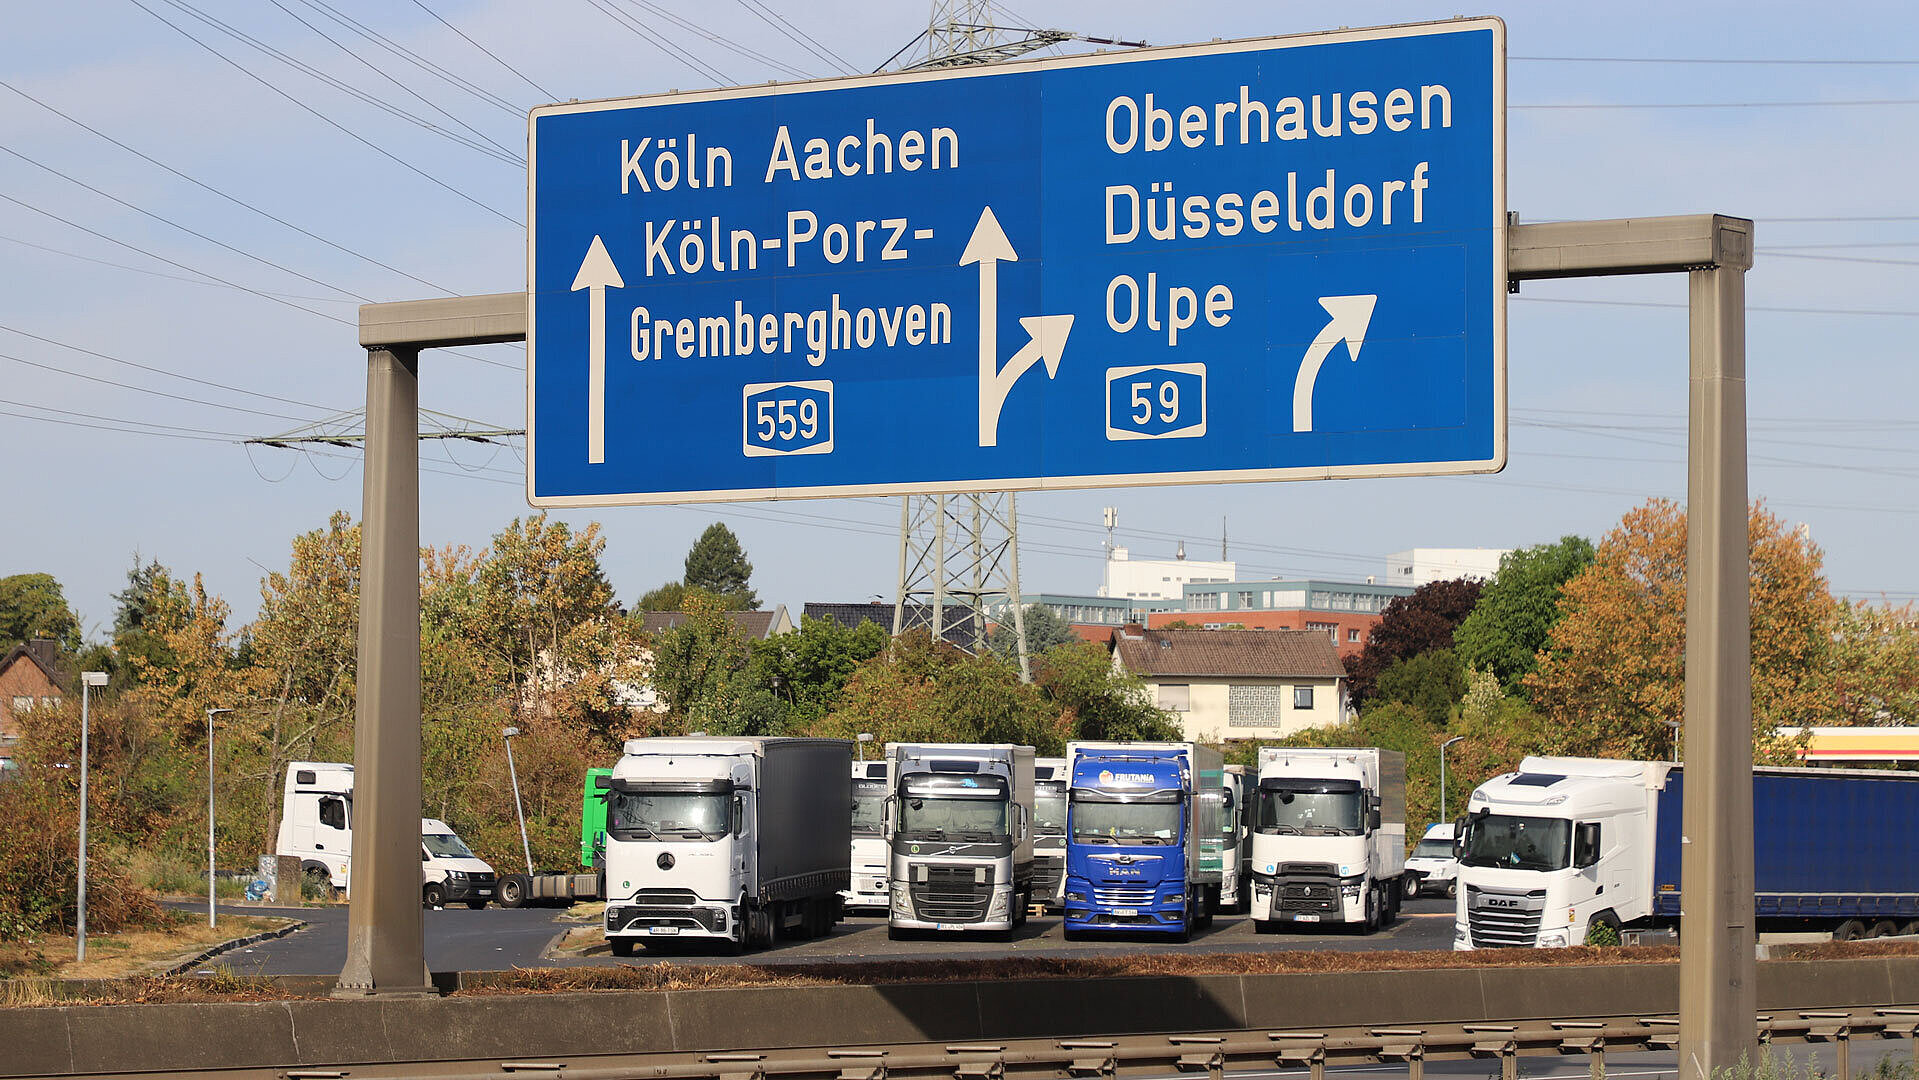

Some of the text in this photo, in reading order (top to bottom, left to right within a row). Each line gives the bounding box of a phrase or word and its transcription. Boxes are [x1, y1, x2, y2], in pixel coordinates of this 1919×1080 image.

[1106, 85, 1452, 154] Oberhausen
[621, 118, 959, 194] Köln Aachen
[1106, 161, 1429, 245] Düsseldorf
[645, 210, 934, 277] Köln-Porz-
[630, 293, 952, 367] Gremberghoven
[1106, 272, 1234, 347] Olpe
[757, 398, 819, 442] 559
[1131, 380, 1180, 425] 59
[1115, 773, 1155, 784] FRUTANIA
[1109, 867, 1141, 876] MAN
[1488, 898, 1519, 907] DAF
